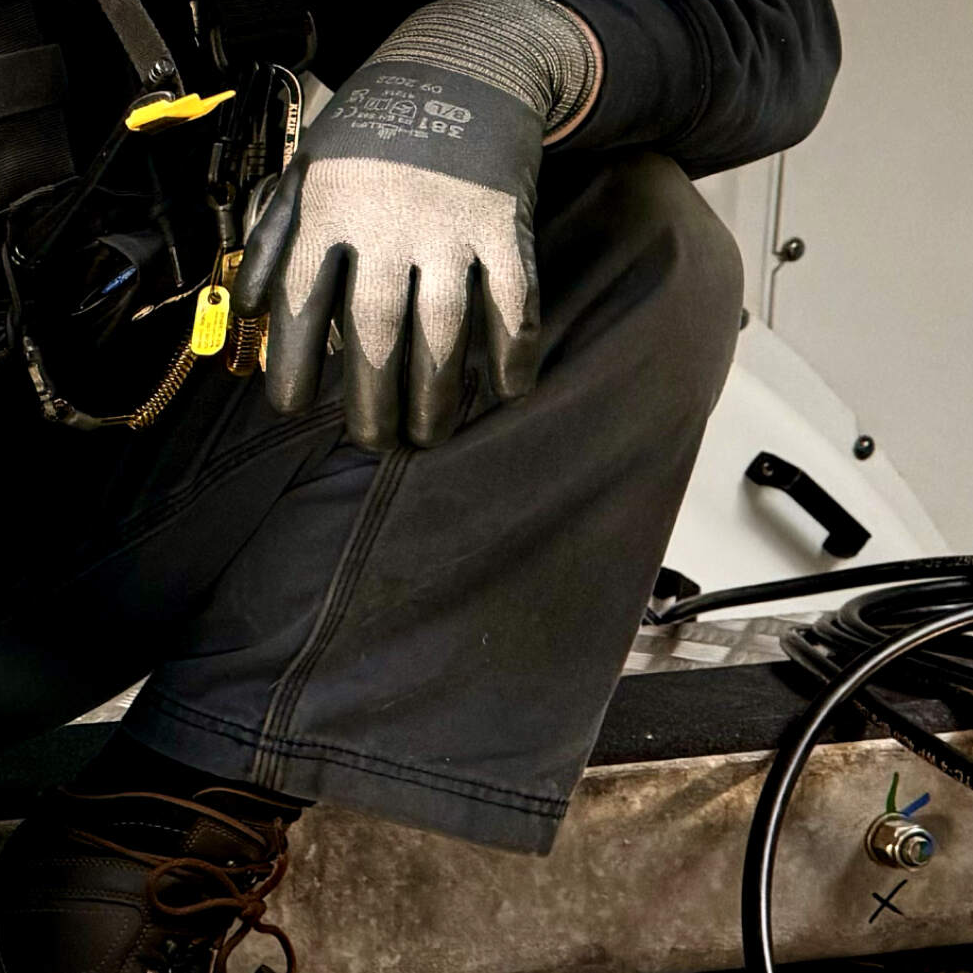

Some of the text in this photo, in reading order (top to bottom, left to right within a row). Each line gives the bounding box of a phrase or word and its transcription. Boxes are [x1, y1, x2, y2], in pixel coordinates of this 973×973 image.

[283, 103, 298, 168] KLEIN TOO
[419, 117, 465, 140] 381
